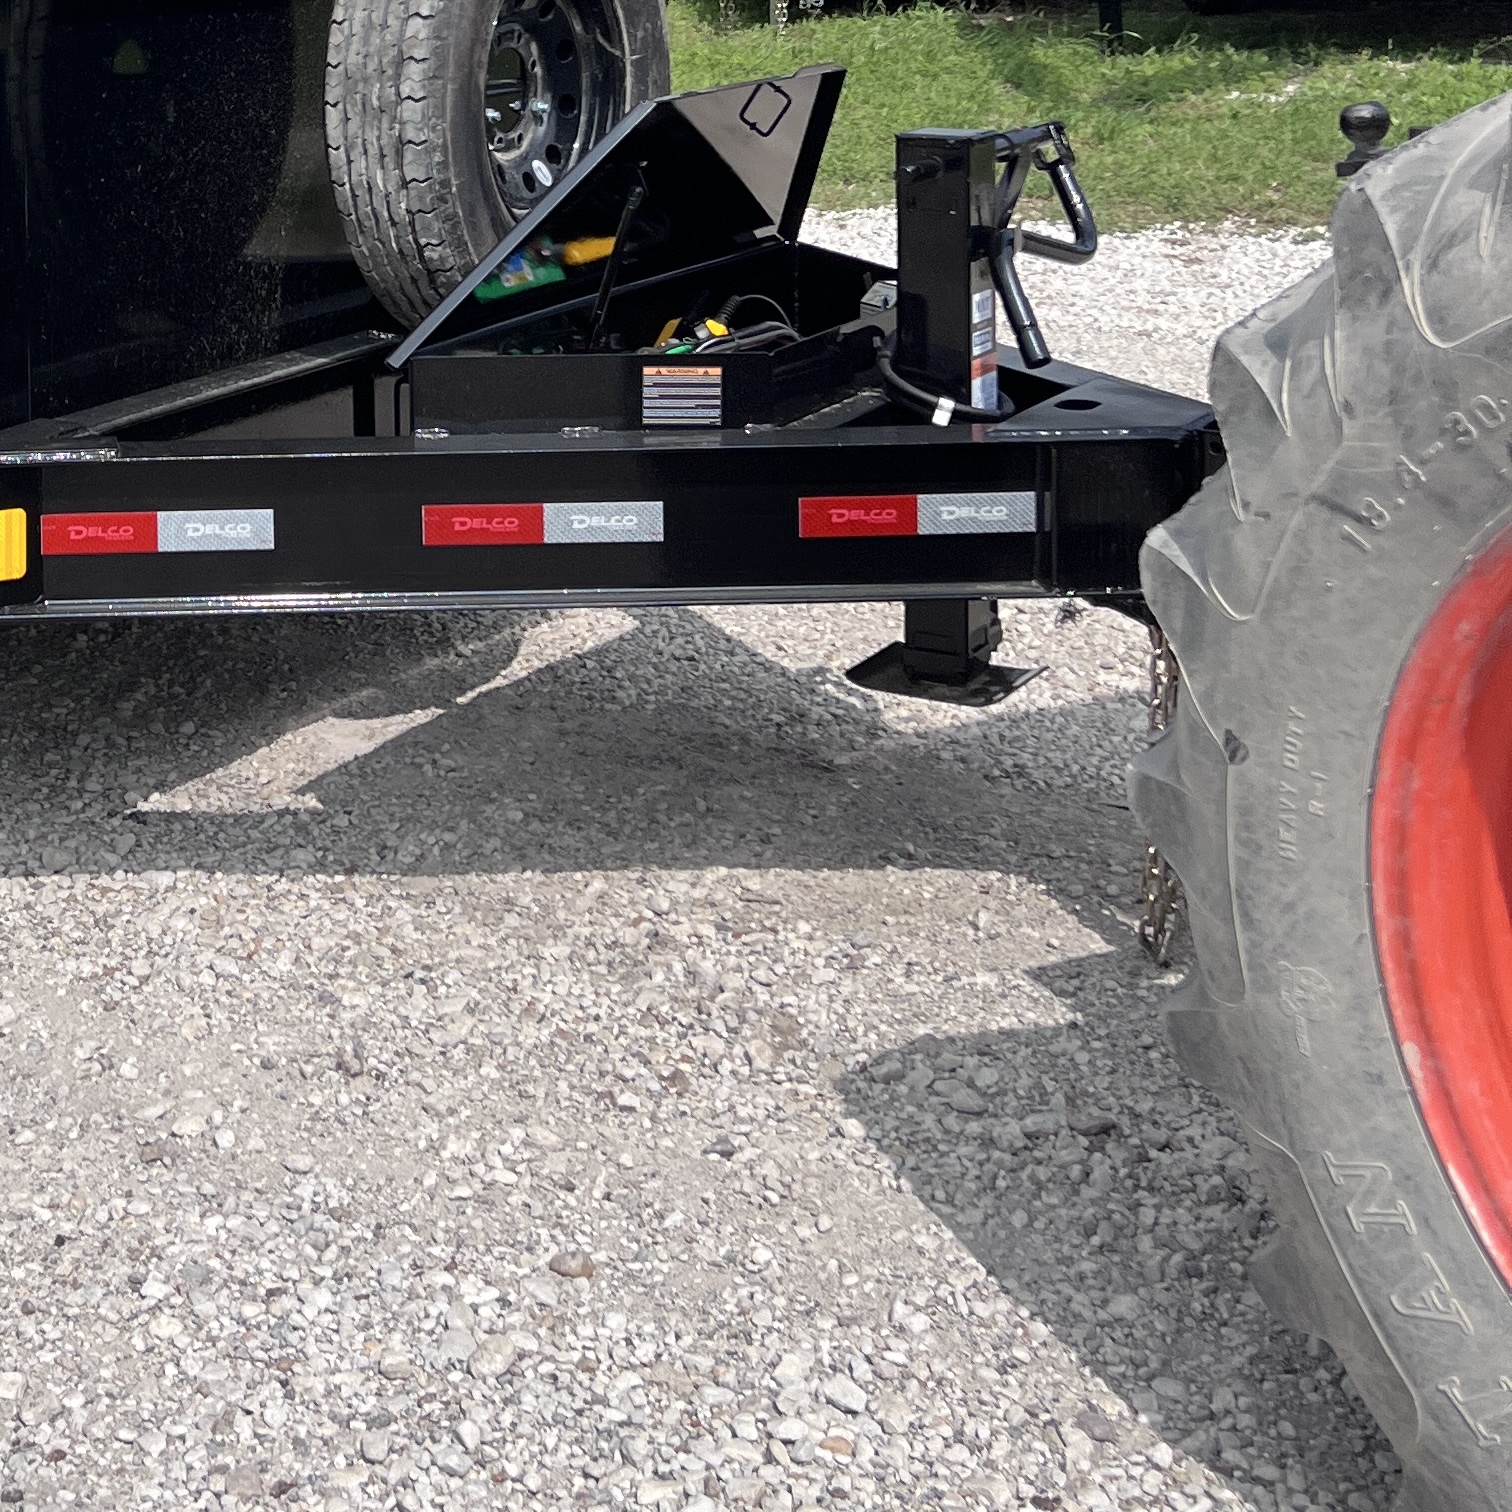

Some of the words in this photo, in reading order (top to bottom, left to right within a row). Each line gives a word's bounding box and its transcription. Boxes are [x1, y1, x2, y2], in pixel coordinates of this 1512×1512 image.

[828, 508, 897, 523] DELCO
[940, 506, 1007, 520] DELCO
[184, 522, 251, 537] DELCO
[451, 517, 519, 531] DELCO
[570, 515, 637, 529] DELCO
[67, 525, 134, 540] DELCO
[1282, 704, 1308, 771] DUTY
[1277, 780, 1300, 863] HEAVY
